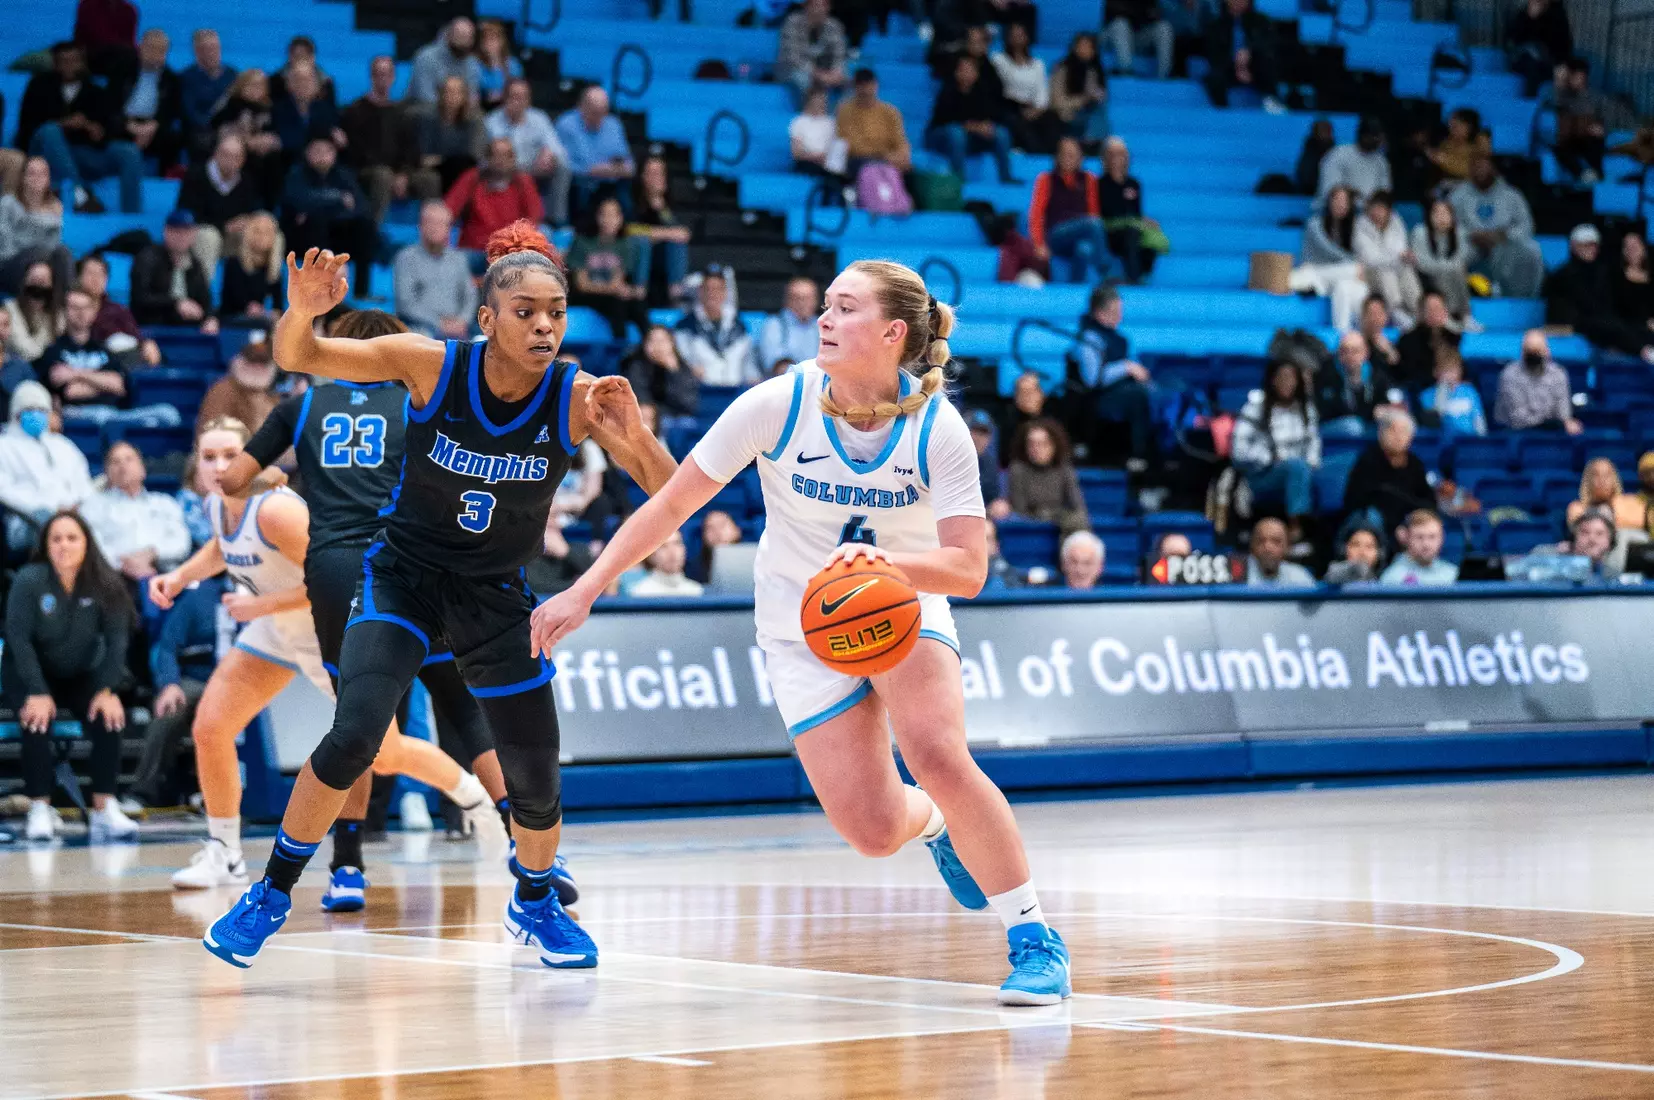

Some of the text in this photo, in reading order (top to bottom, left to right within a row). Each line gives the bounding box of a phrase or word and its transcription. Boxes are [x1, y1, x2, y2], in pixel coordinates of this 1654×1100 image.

[321, 412, 387, 468] 23
[427, 429, 549, 484] Memphis
[457, 490, 497, 533] 3
[791, 473, 919, 508] COLUMBIA
[837, 514, 877, 547] 4
[827, 618, 895, 652] ELITE
[555, 646, 737, 712] fficial
[1017, 637, 1074, 697] of
[1088, 632, 1351, 695] Columbia
[1366, 629, 1589, 688] Athletics
